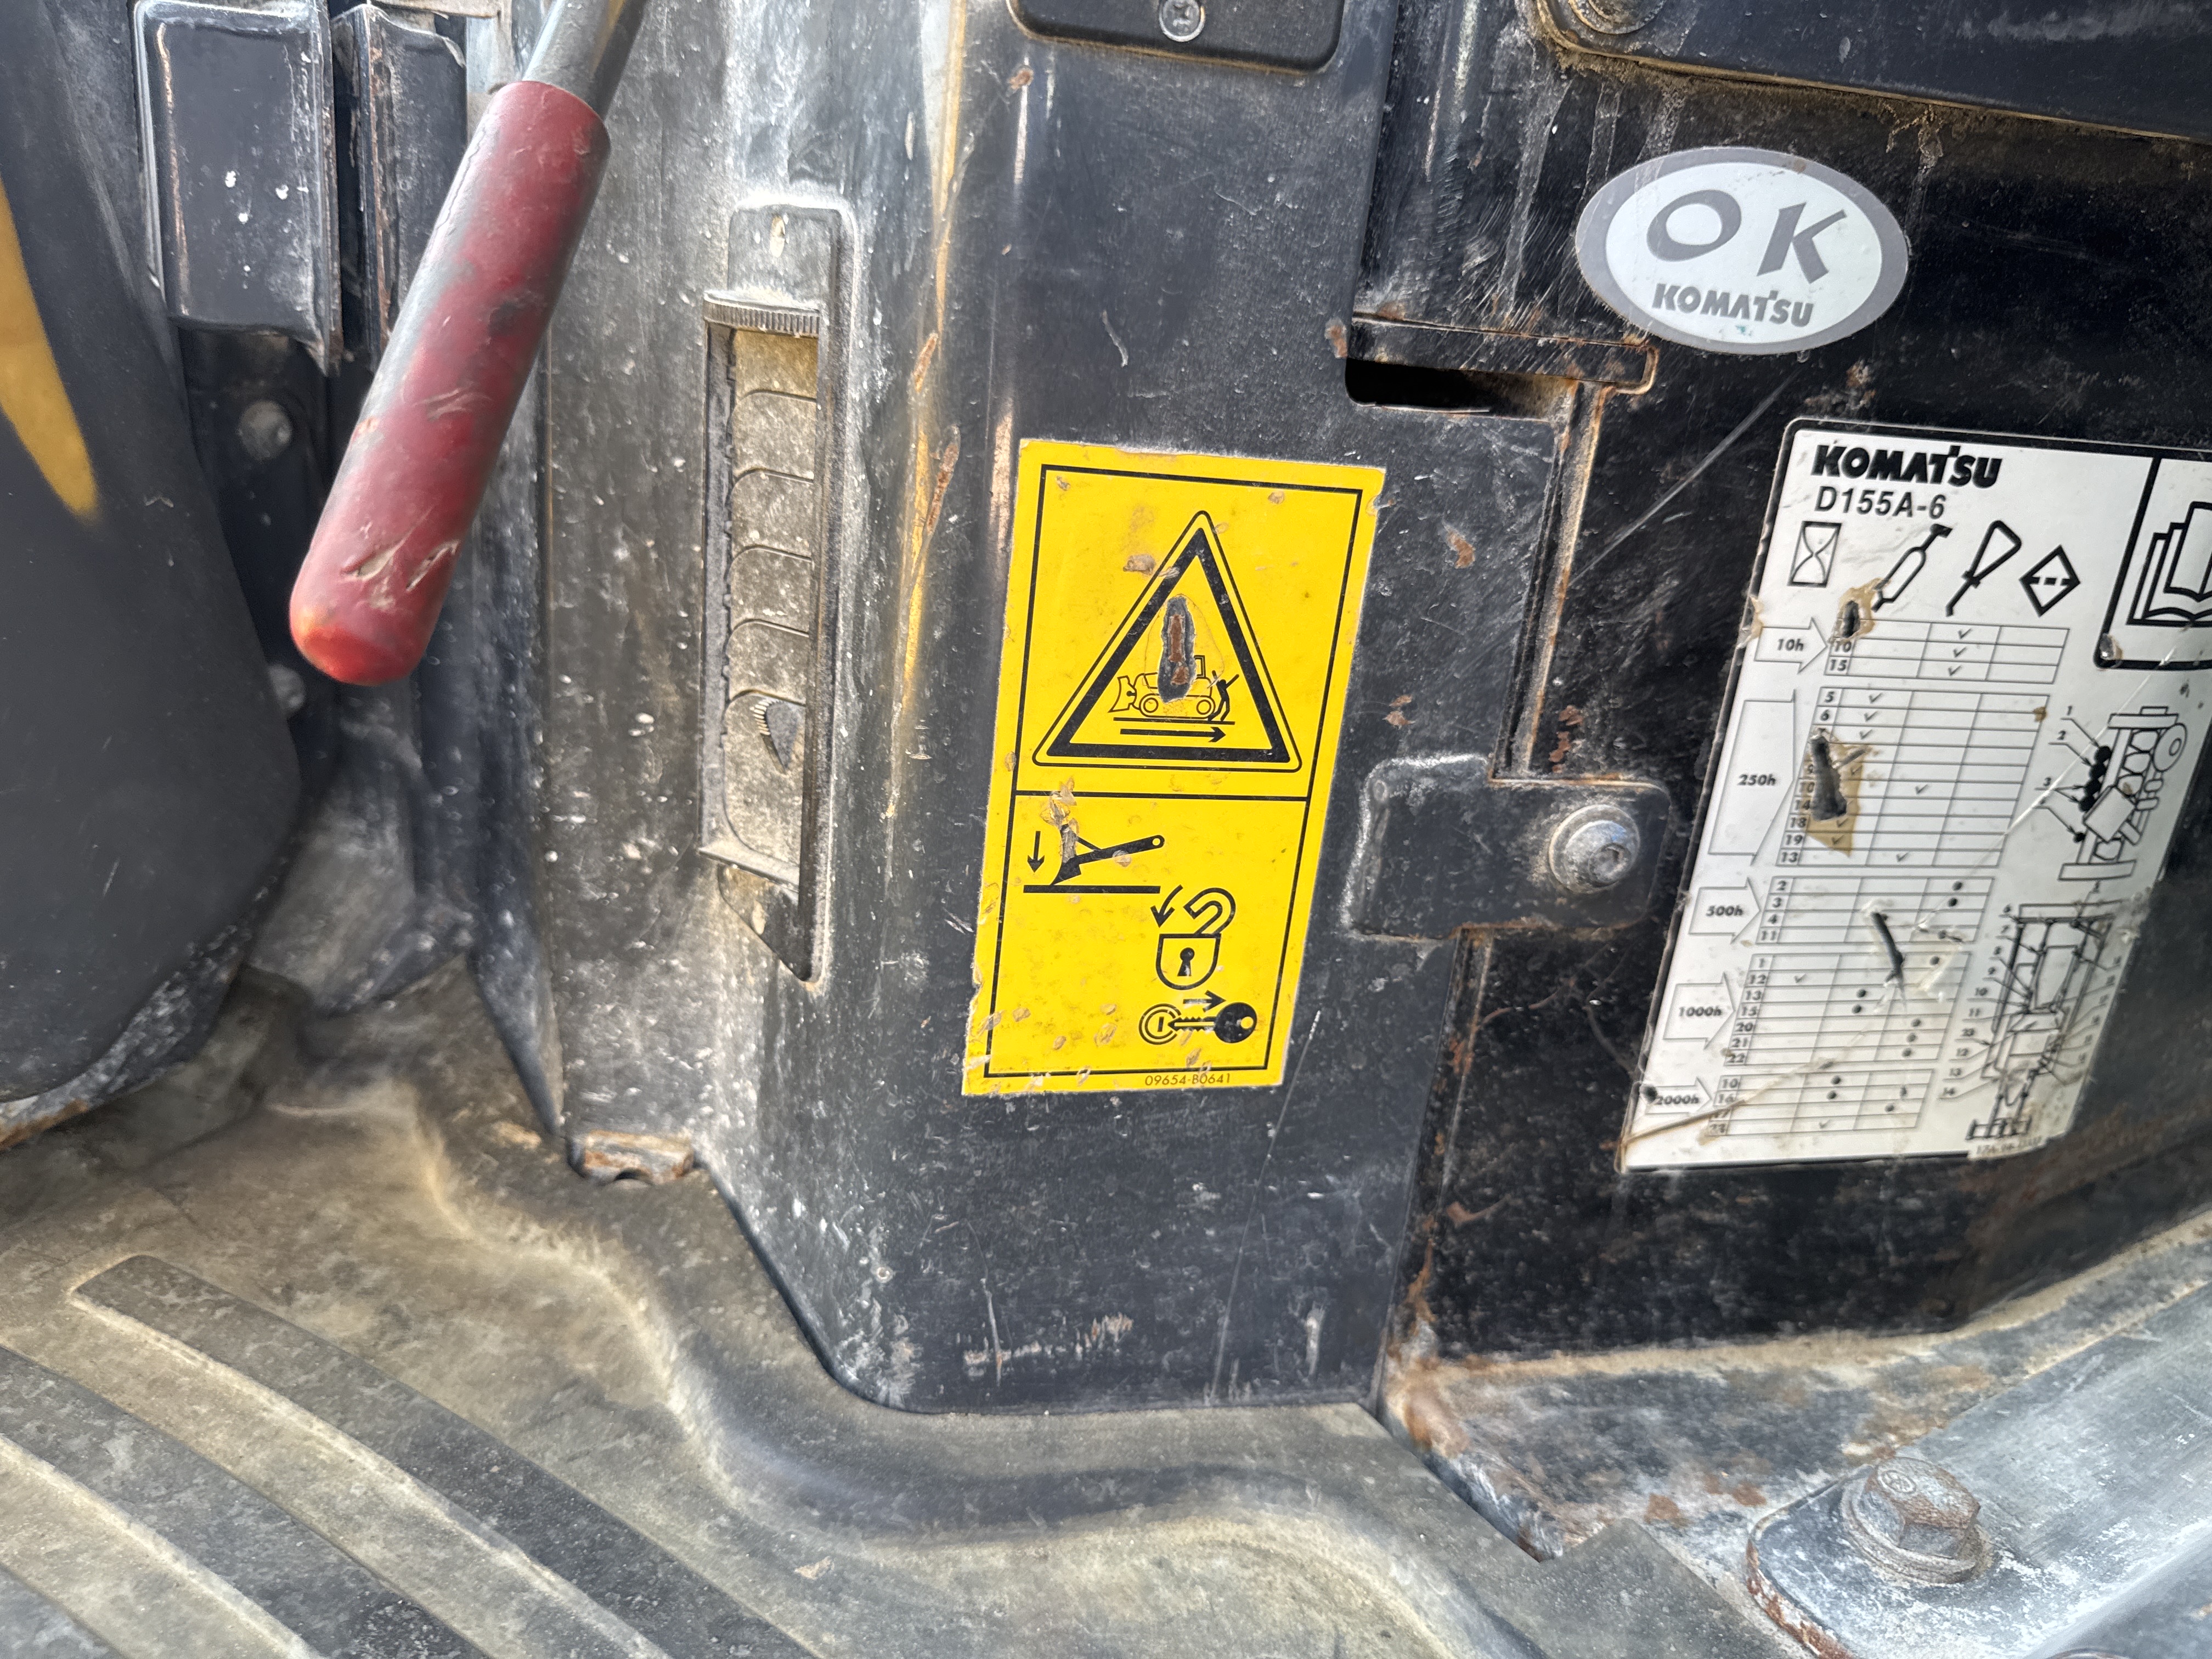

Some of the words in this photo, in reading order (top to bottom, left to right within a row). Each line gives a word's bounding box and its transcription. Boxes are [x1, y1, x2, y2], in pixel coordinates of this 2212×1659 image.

[1652, 282, 1815, 328] KOMATSU
[1811, 442, 2003, 489] KOMATSU
[1814, 486, 1948, 520] D155A-6
[1778, 639, 1803, 651] 10h
[1834, 641, 1851, 652] 10
[1830, 660, 1847, 670] 15
[1825, 691, 1835, 703] 5
[1820, 709, 1829, 720] 6
[2067, 705, 2073, 715] 1
[2057, 730, 2066, 740] 2
[1738, 774, 1776, 787] 250h
[2044, 777, 2051, 786] 3
[1791, 817, 1807, 828] 18
[1786, 834, 1803, 845] 19
[1781, 852, 1798, 862] 13
[1776, 881, 1786, 890] 2
[1772, 897, 1782, 907] 3
[1706, 904, 1743, 916] 500h
[1768, 914, 1778, 924] 4
[1762, 930, 1776, 940] 11
[1759, 958, 1764, 967] 1
[1750, 974, 1767, 984] 12
[1746, 991, 1762, 1000] 13
[1679, 1006, 1722, 1016] 1000h
[1742, 1006, 1757, 1015] 15
[1736, 1023, 1753, 1031] 20
[1732, 1038, 1747, 1047] 21
[1144, 1073, 1231, 1086] 09654-B0641
[1723, 1079, 1737, 1088] 10
[1656, 1094, 1699, 1104] 2000h
[1718, 1093, 1735, 1103] 16
